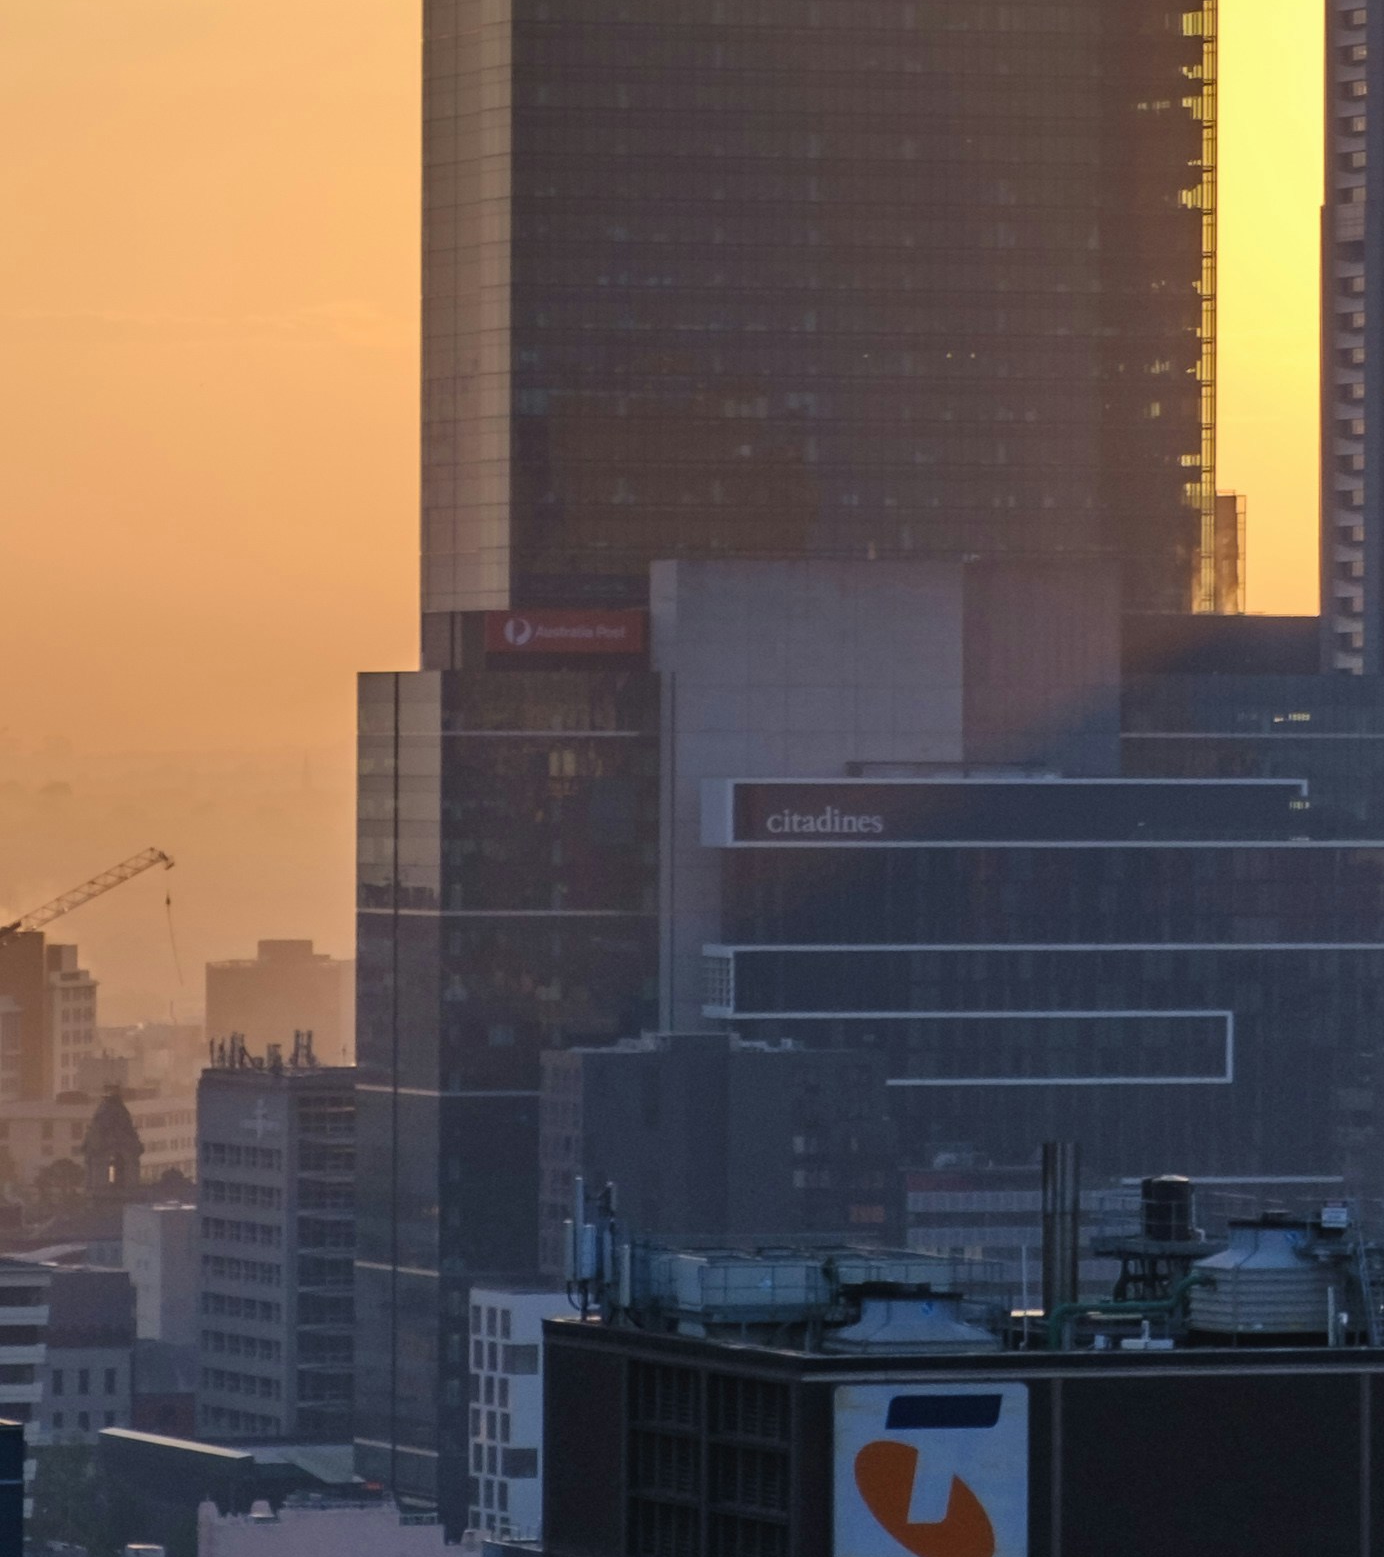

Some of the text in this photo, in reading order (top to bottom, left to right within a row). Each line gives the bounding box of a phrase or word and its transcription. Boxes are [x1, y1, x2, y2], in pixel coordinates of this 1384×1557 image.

[535, 624, 625, 638] Australia Post
[766, 805, 883, 833] citadines
